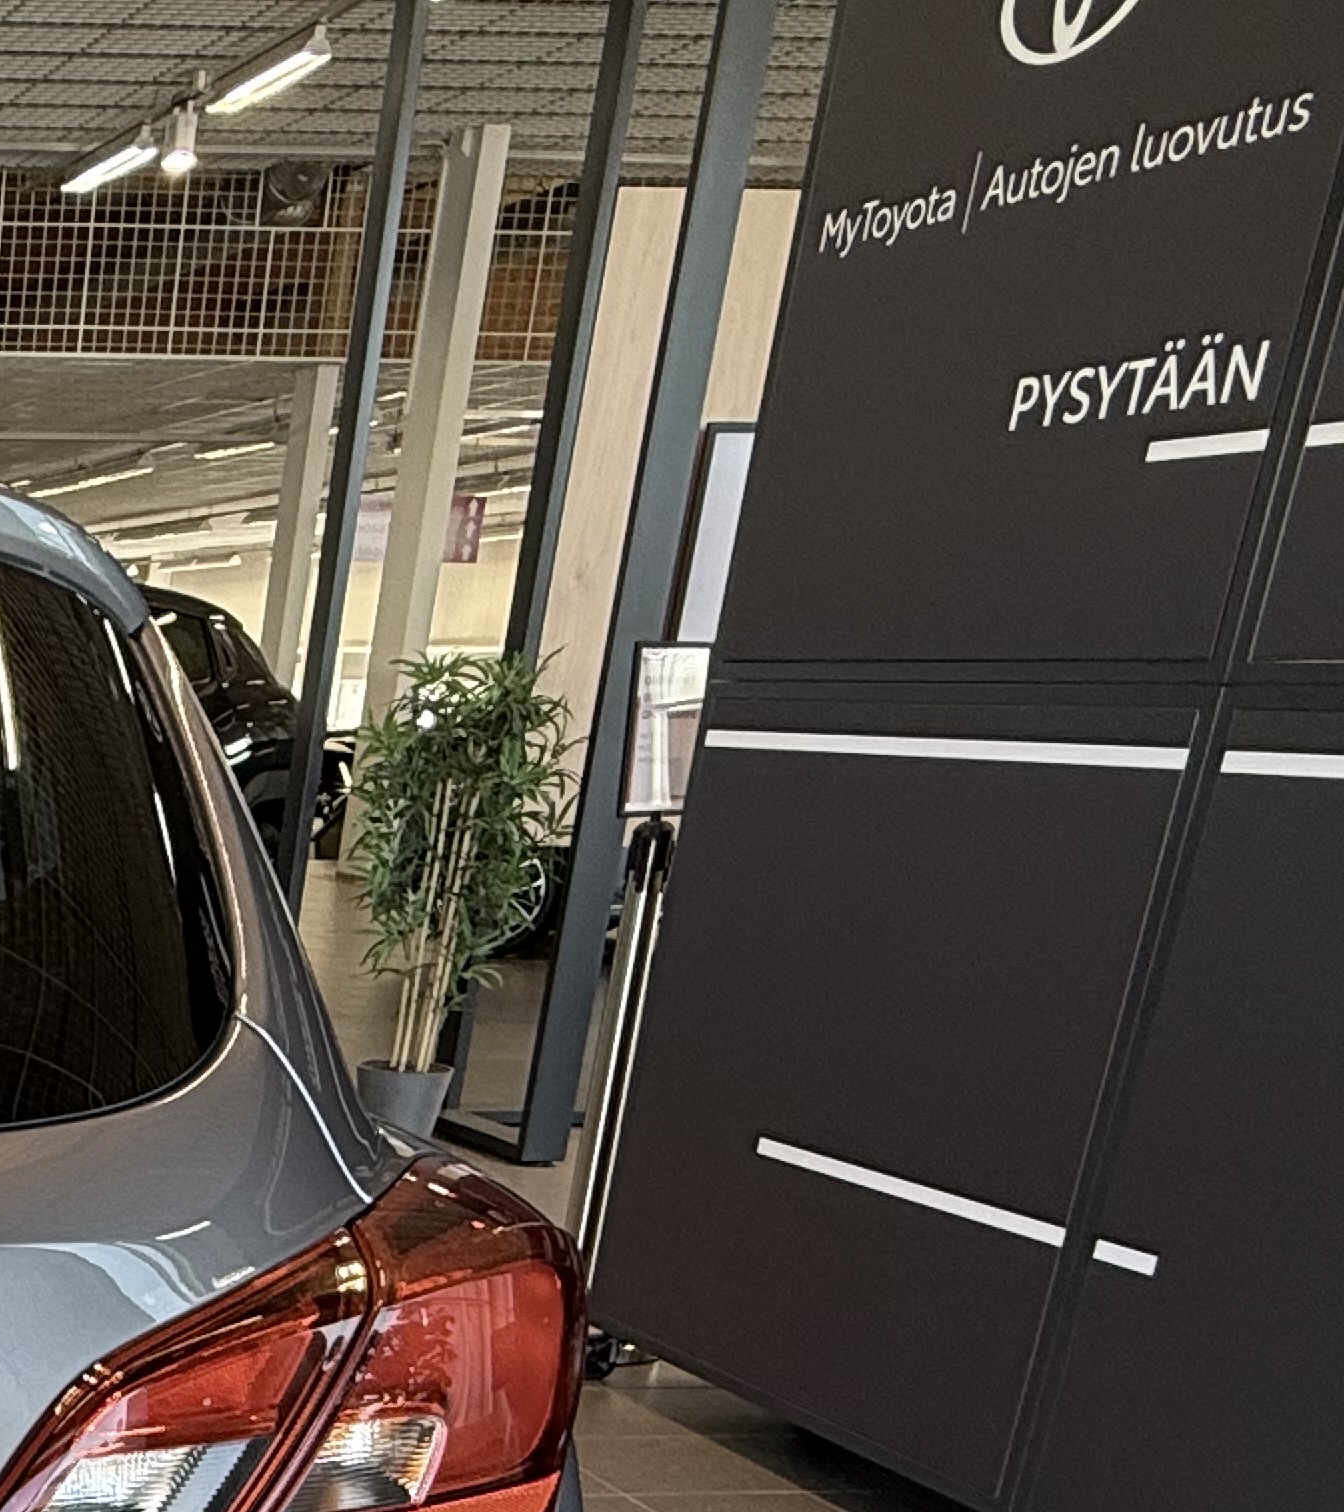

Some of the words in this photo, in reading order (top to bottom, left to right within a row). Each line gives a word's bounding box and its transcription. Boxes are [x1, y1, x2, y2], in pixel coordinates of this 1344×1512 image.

[818, 186, 957, 260] MyToyota
[979, 143, 1121, 211] Autojen
[1129, 91, 1315, 174] luovutus
[1006, 331, 1271, 433] PYSYTÄÄN
